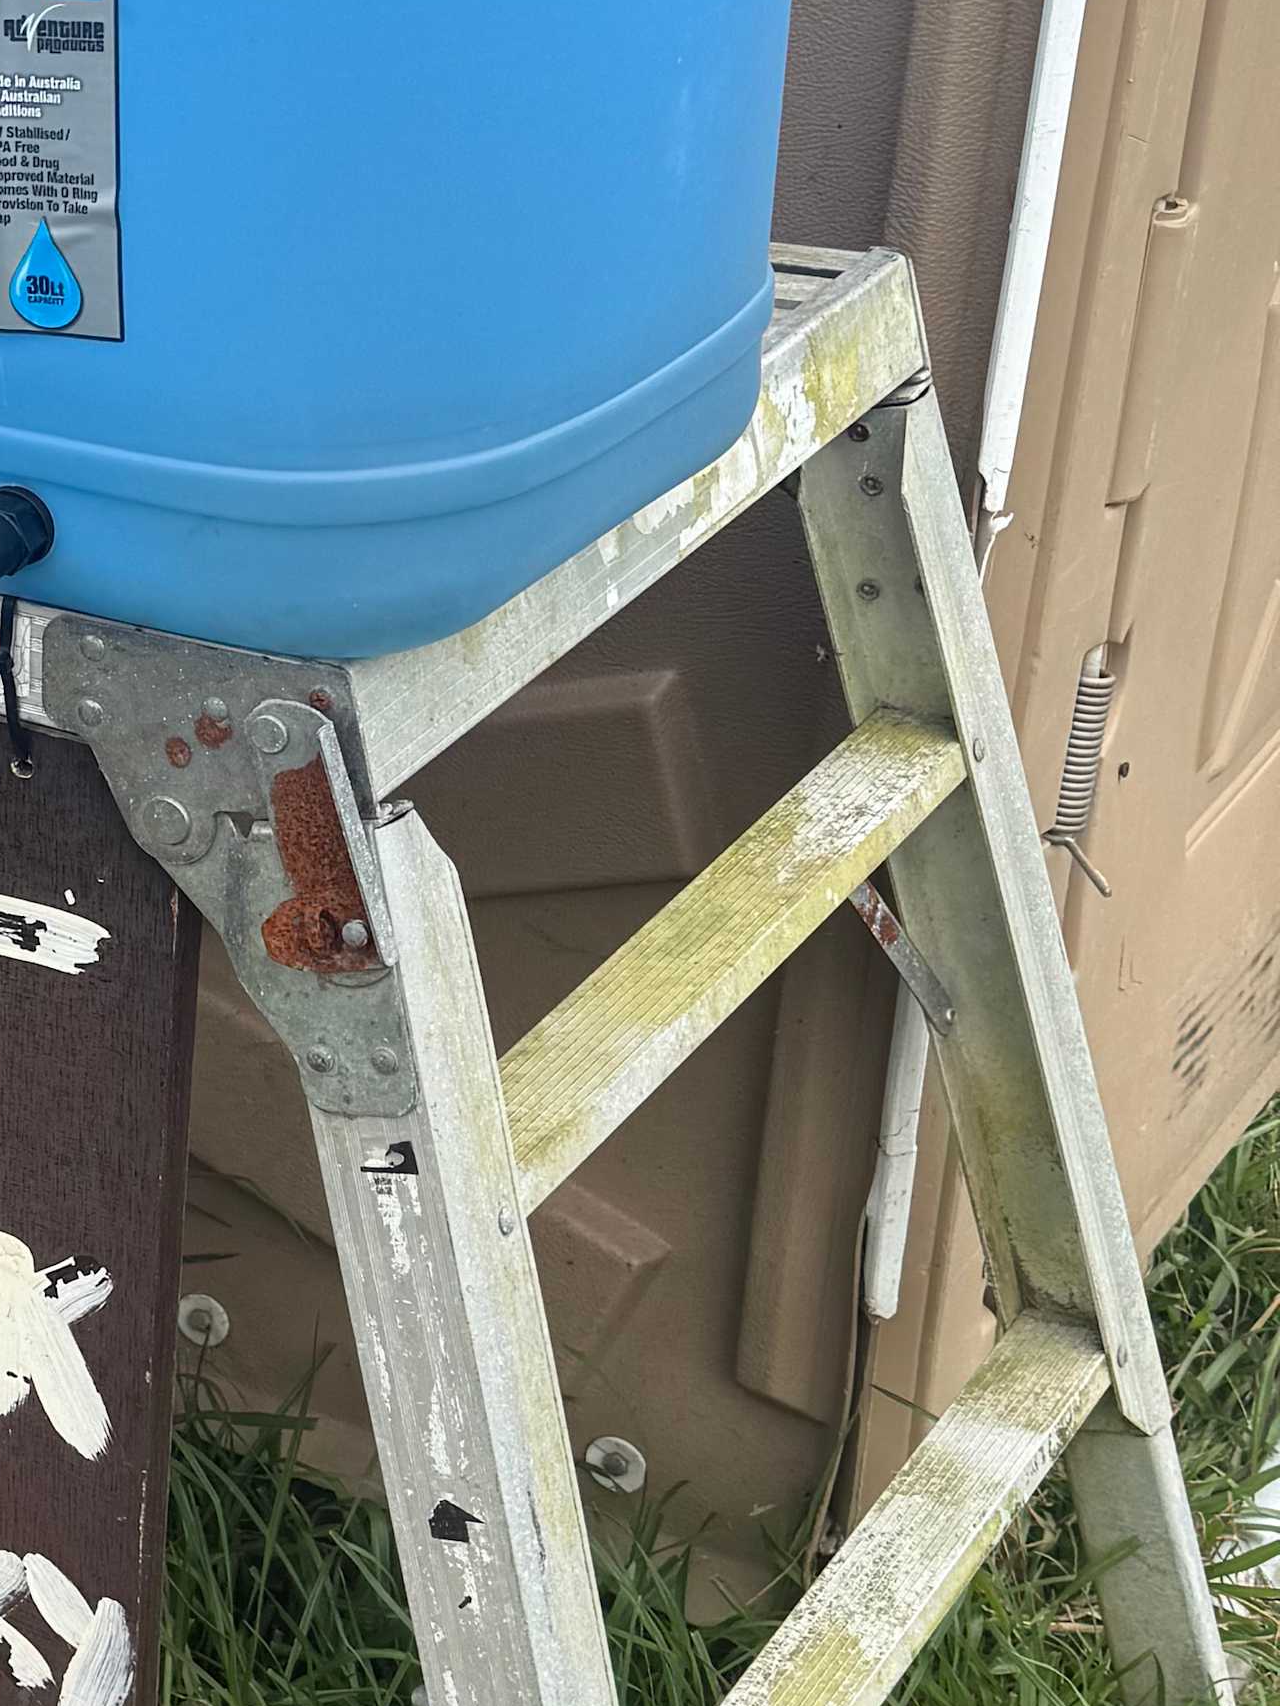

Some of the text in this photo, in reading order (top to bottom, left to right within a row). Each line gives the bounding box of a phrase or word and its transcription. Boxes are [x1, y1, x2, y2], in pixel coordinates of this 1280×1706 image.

[28, 75, 81, 91] Australia
[0, 90, 61, 104] Australian
[15, 141, 40, 153] Free
[20, 155, 29, 167] &
[32, 156, 60, 171] Drug
[47, 171, 95, 186] Material
[32, 185, 58, 198] With
[72, 187, 98, 204] Ring
[46, 200, 59, 212] To
[62, 200, 88, 214] Take
[25, 275, 65, 296] 30Lt
